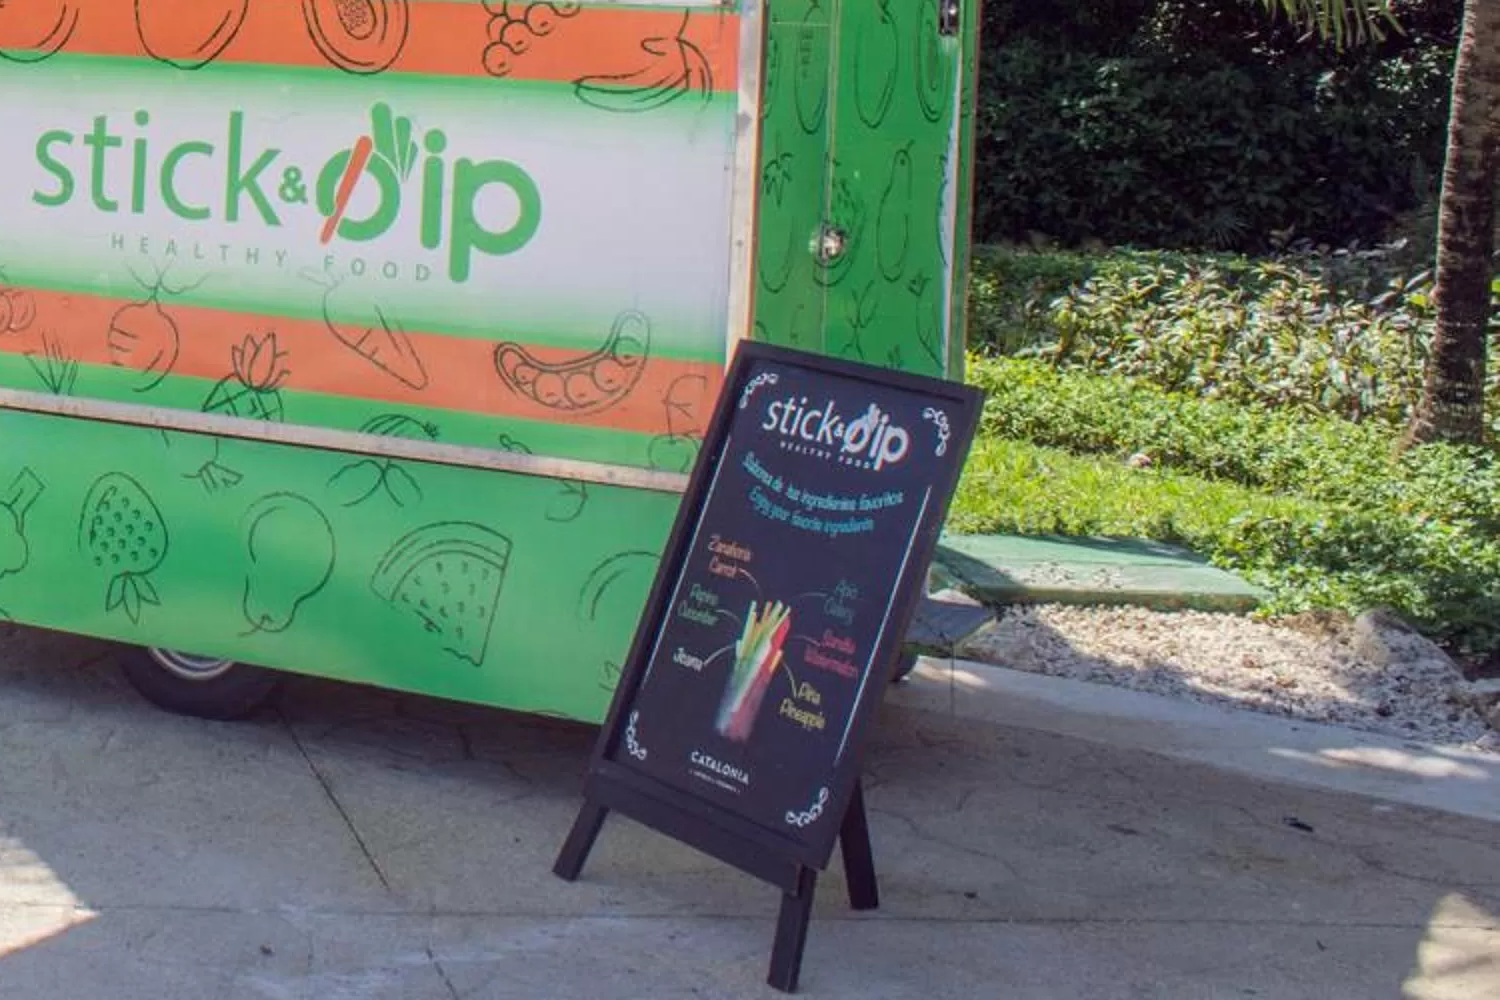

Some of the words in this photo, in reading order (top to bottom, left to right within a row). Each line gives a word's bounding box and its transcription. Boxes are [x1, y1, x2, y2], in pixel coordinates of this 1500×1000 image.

[111, 233, 288, 268] HEALTHY
[323, 257, 431, 283] FOOD
[691, 751, 749, 786] CATALONIA
